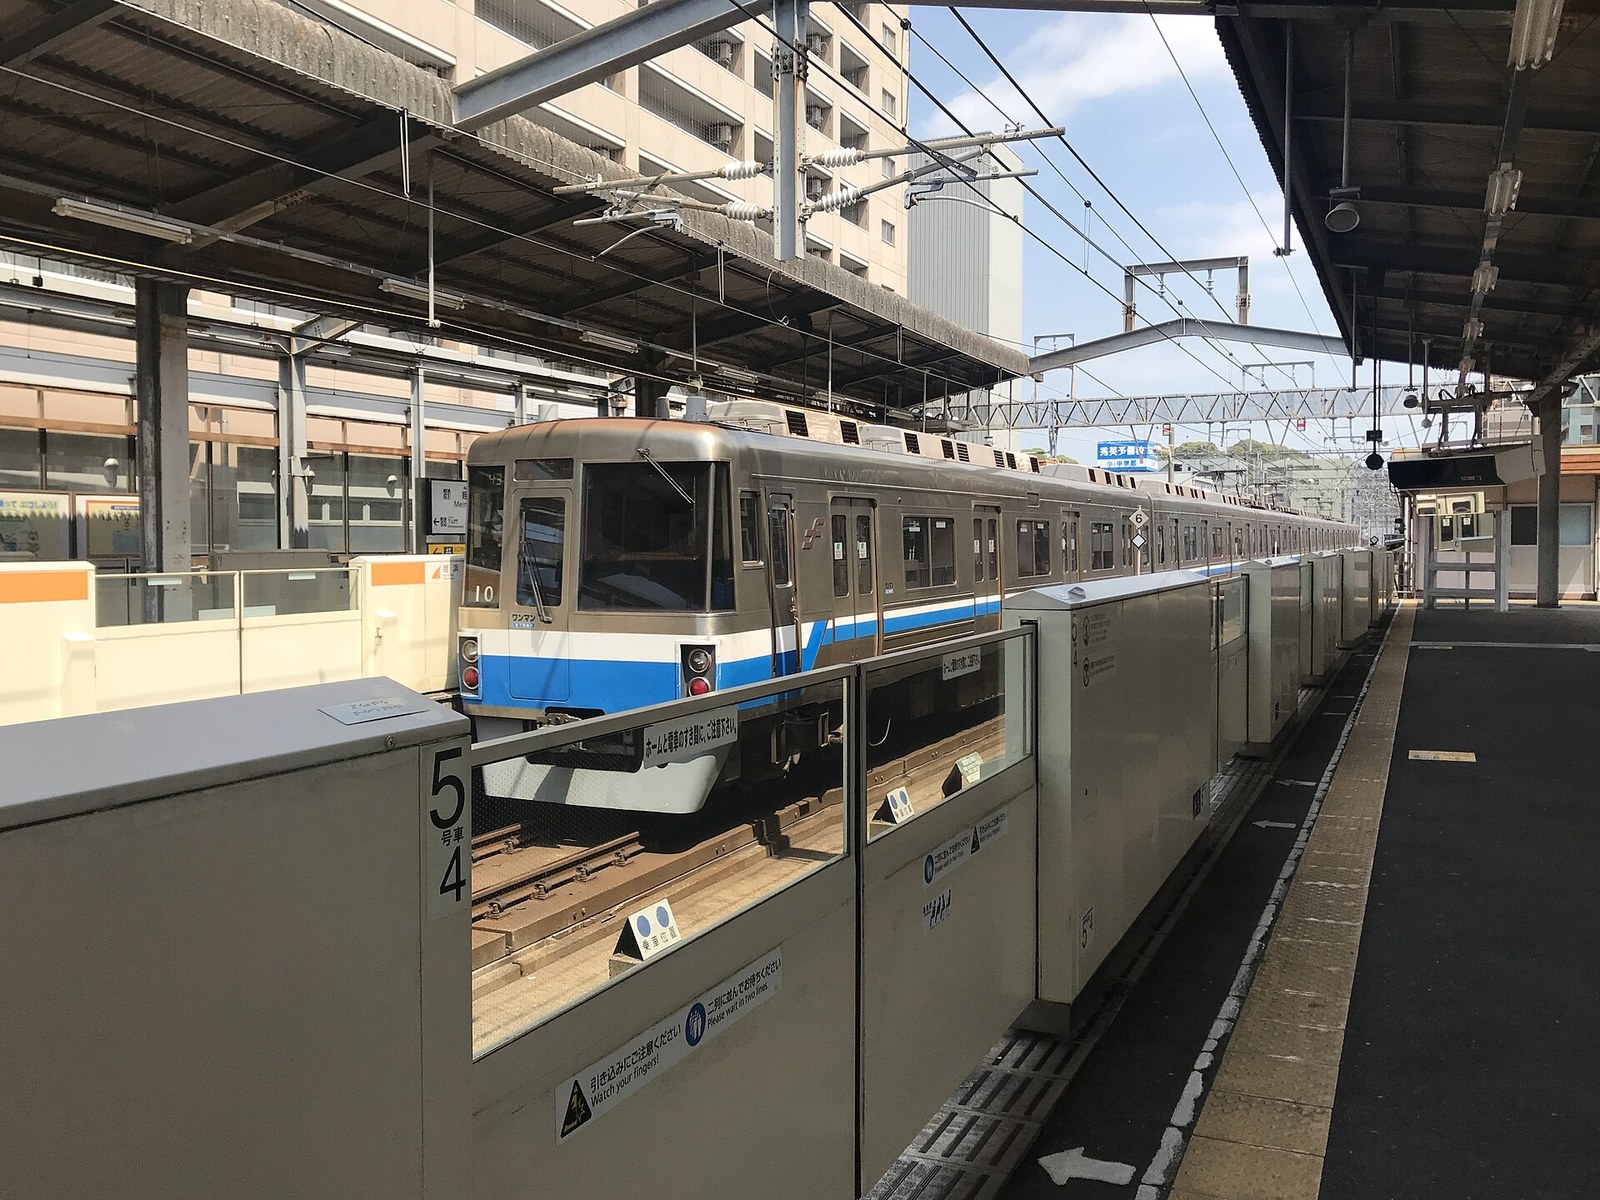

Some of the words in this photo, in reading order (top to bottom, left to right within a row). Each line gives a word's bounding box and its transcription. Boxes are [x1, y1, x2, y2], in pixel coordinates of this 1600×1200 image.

[1135, 514, 1143, 523] 6
[475, 585, 494, 603] 10
[512, 614, 536, 622] ワンマン
[429, 747, 465, 829] 5
[441, 826, 464, 847] 号車
[439, 845, 466, 902] 4
[708, 958, 781, 1015] 二列に並んでお待ちください
[707, 1011, 726, 1030] Please
[726, 1002, 738, 1017] wait
[739, 996, 745, 1008] in
[745, 991, 755, 1004] two
[590, 1024, 681, 1093] 引き込みにご注意ください
[591, 1085, 615, 1108] Watch
[616, 1073, 632, 1094] your
[633, 1053, 660, 1079] fingers!
